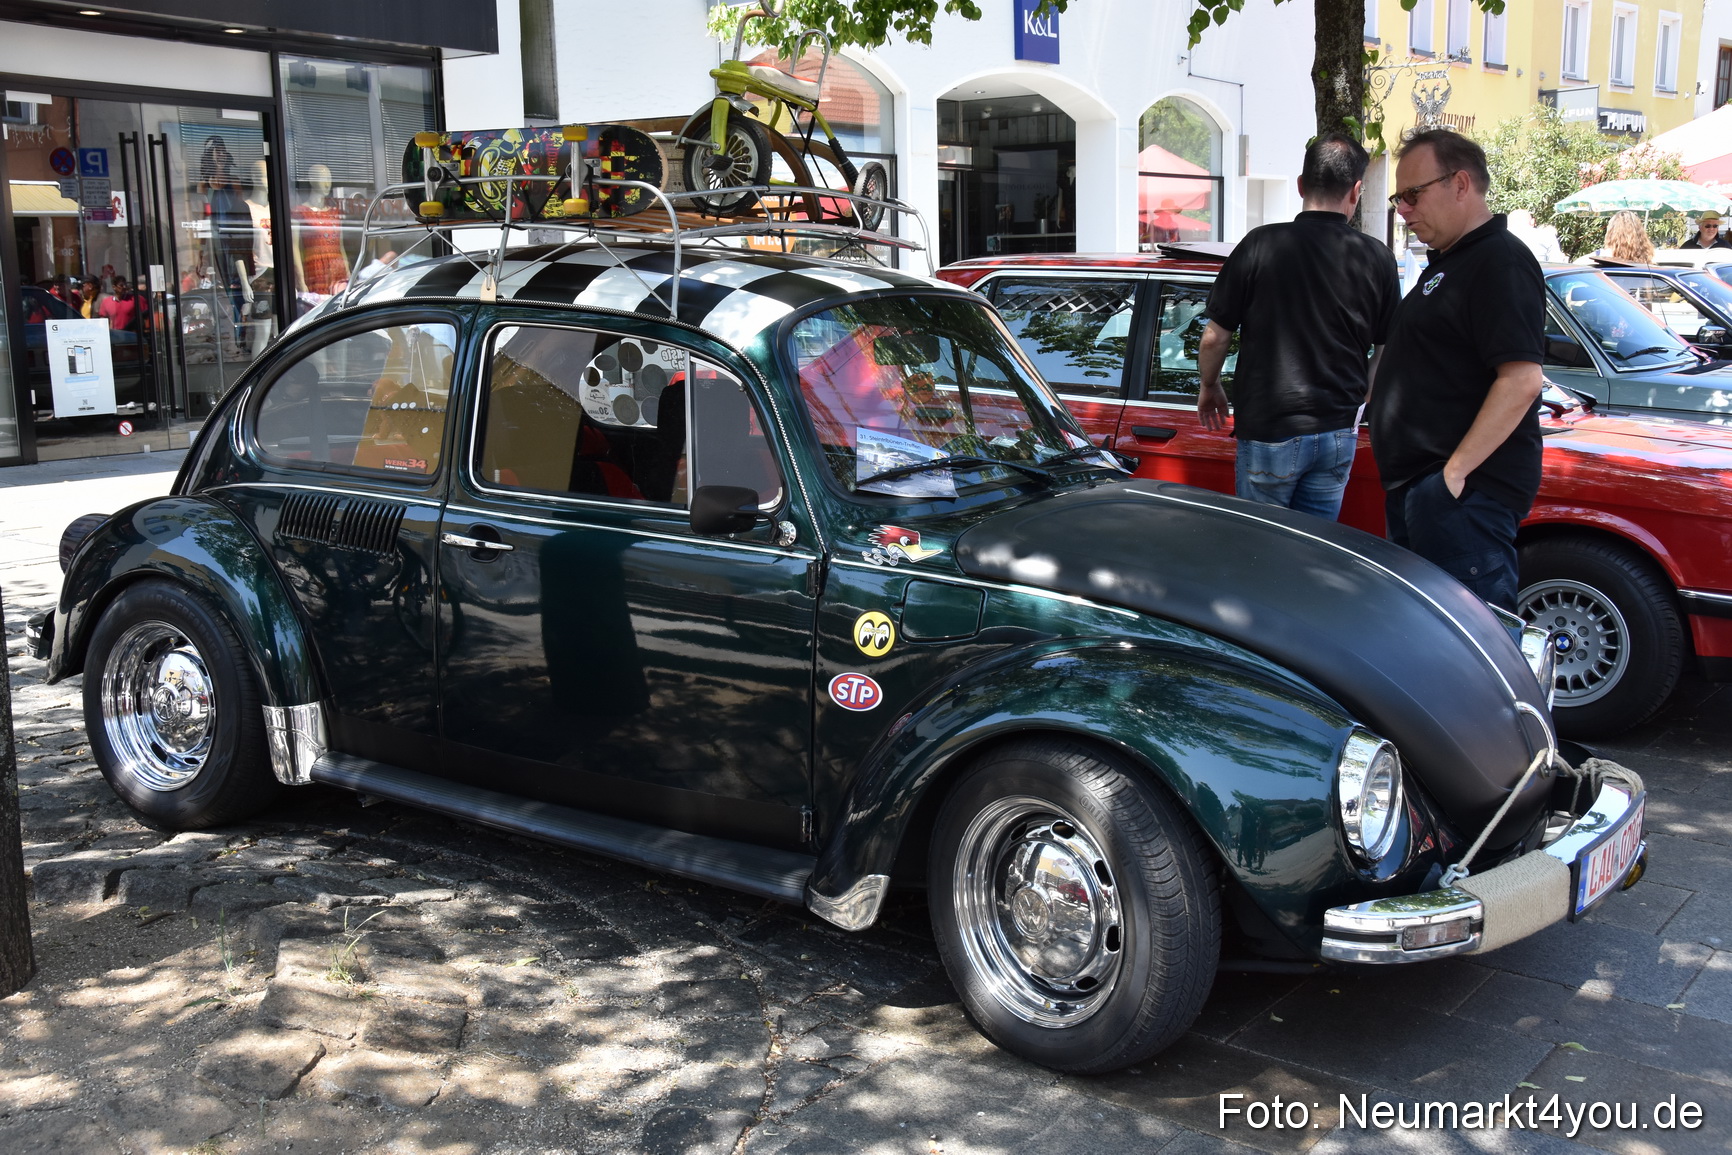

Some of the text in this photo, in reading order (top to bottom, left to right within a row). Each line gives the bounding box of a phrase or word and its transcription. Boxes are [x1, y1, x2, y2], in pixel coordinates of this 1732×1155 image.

[1024, 9, 1057, 38] K&L
[1600, 111, 1647, 133] TAIFUN
[863, 626, 887, 635] MOON
[836, 677, 875, 705] STP
[1588, 840, 1616, 898] LAU
